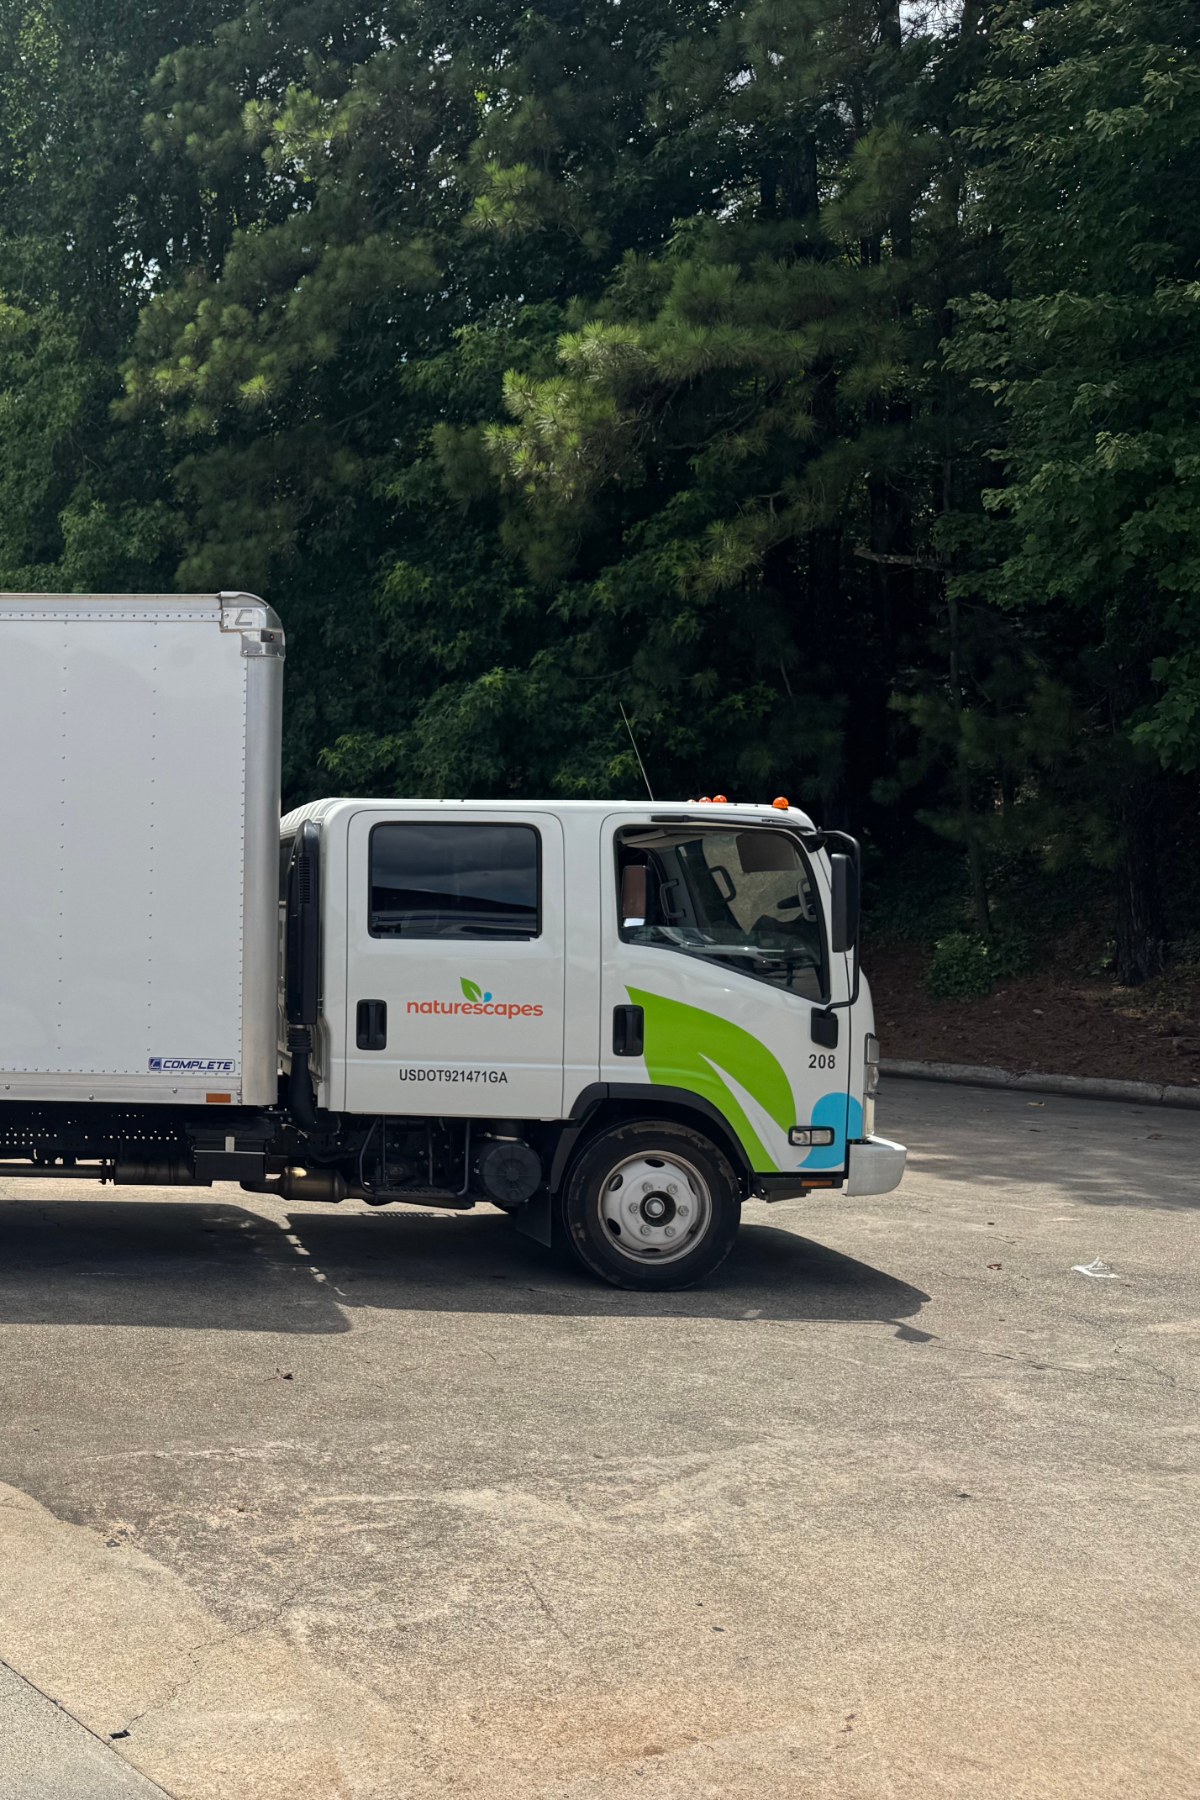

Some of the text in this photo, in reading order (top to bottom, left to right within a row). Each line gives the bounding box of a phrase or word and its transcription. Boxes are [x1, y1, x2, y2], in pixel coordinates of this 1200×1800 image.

[406, 1000, 544, 1020] naturescapes
[162, 1059, 233, 1071] COMPLETE
[808, 1053, 836, 1070] 208
[399, 1068, 508, 1084] USDOT921471GA
